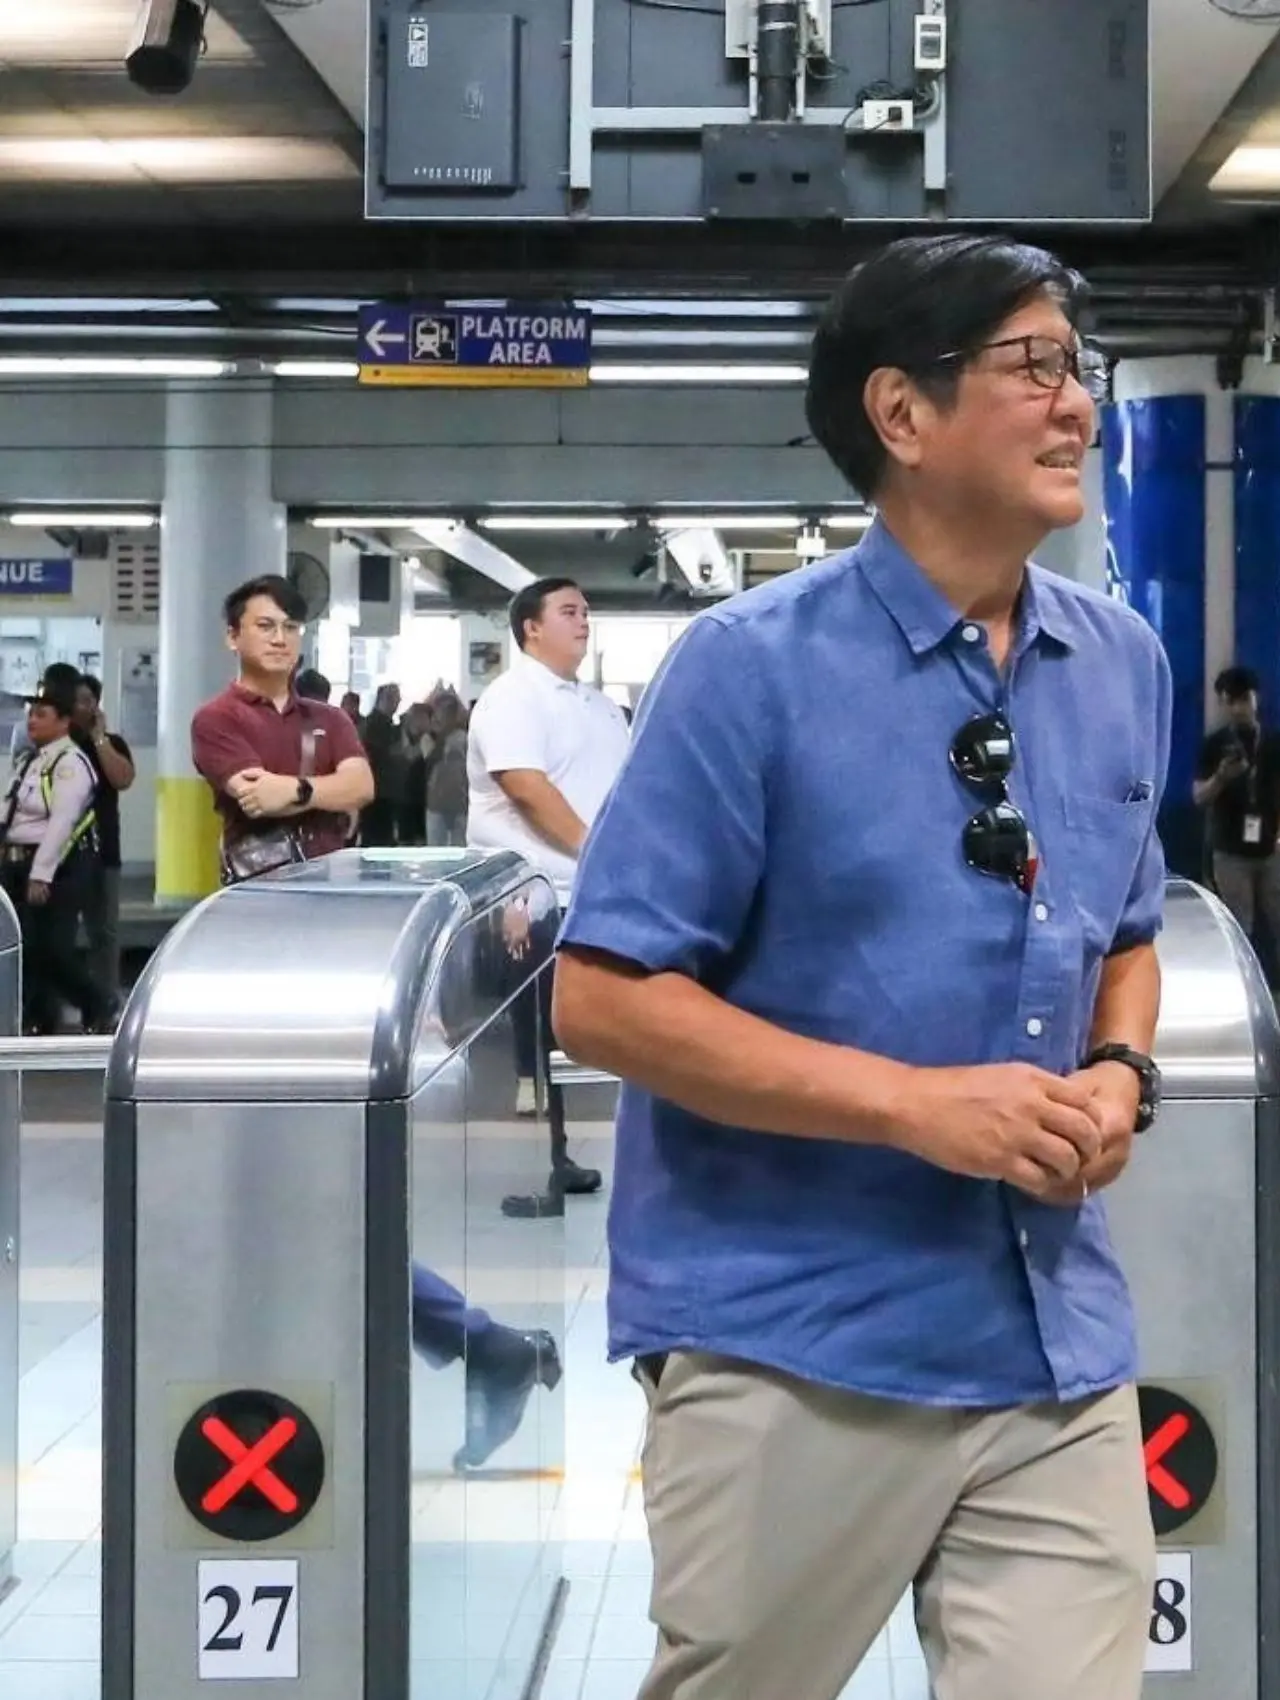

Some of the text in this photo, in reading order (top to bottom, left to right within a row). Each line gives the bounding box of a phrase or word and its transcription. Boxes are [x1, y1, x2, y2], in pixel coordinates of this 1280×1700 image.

[461, 315, 586, 339] PLATFORM
[488, 342, 552, 364] AREA
[203, 1583, 294, 1651] 27
[1148, 1577, 1187, 1644] 8
